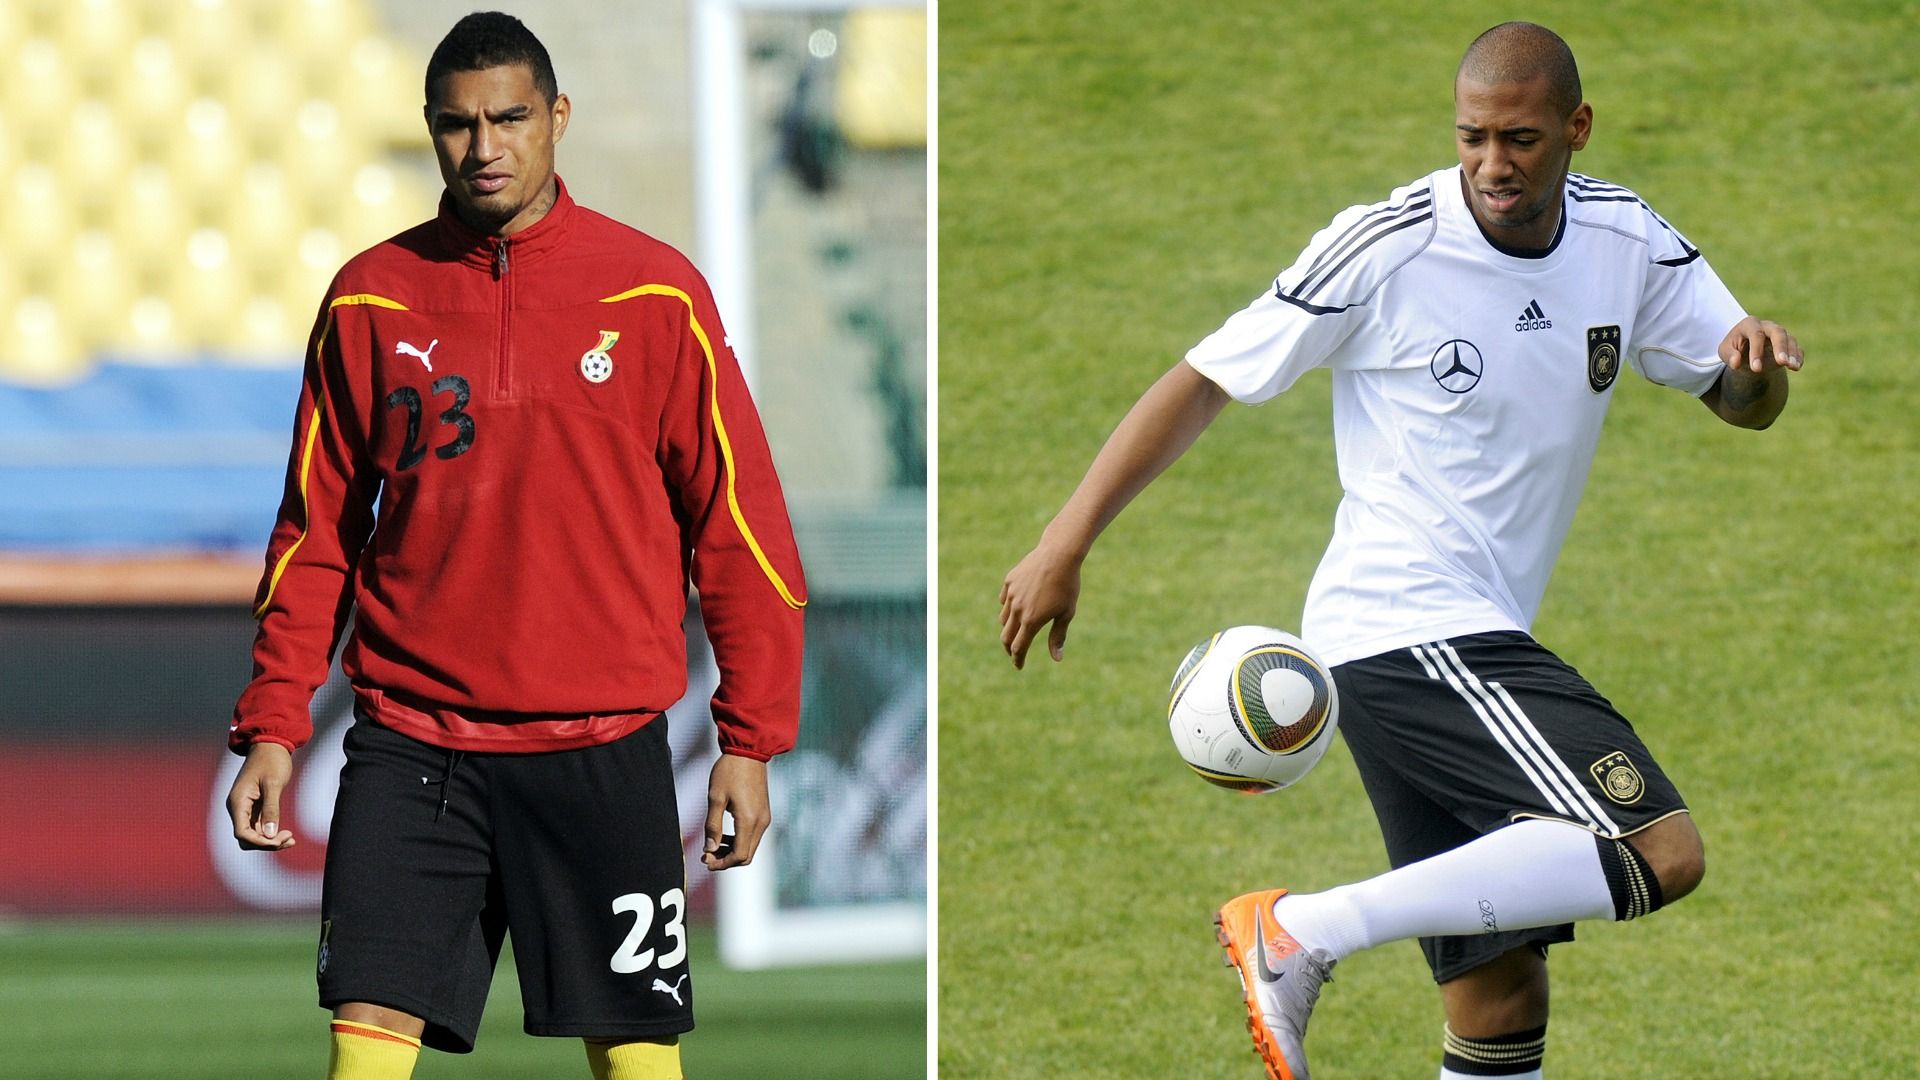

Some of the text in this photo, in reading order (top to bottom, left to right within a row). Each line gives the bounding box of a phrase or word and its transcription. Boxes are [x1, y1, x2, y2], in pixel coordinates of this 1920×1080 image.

[1515, 318, 1552, 332] adidas
[387, 374, 476, 472] 23
[610, 888, 687, 974] 23
